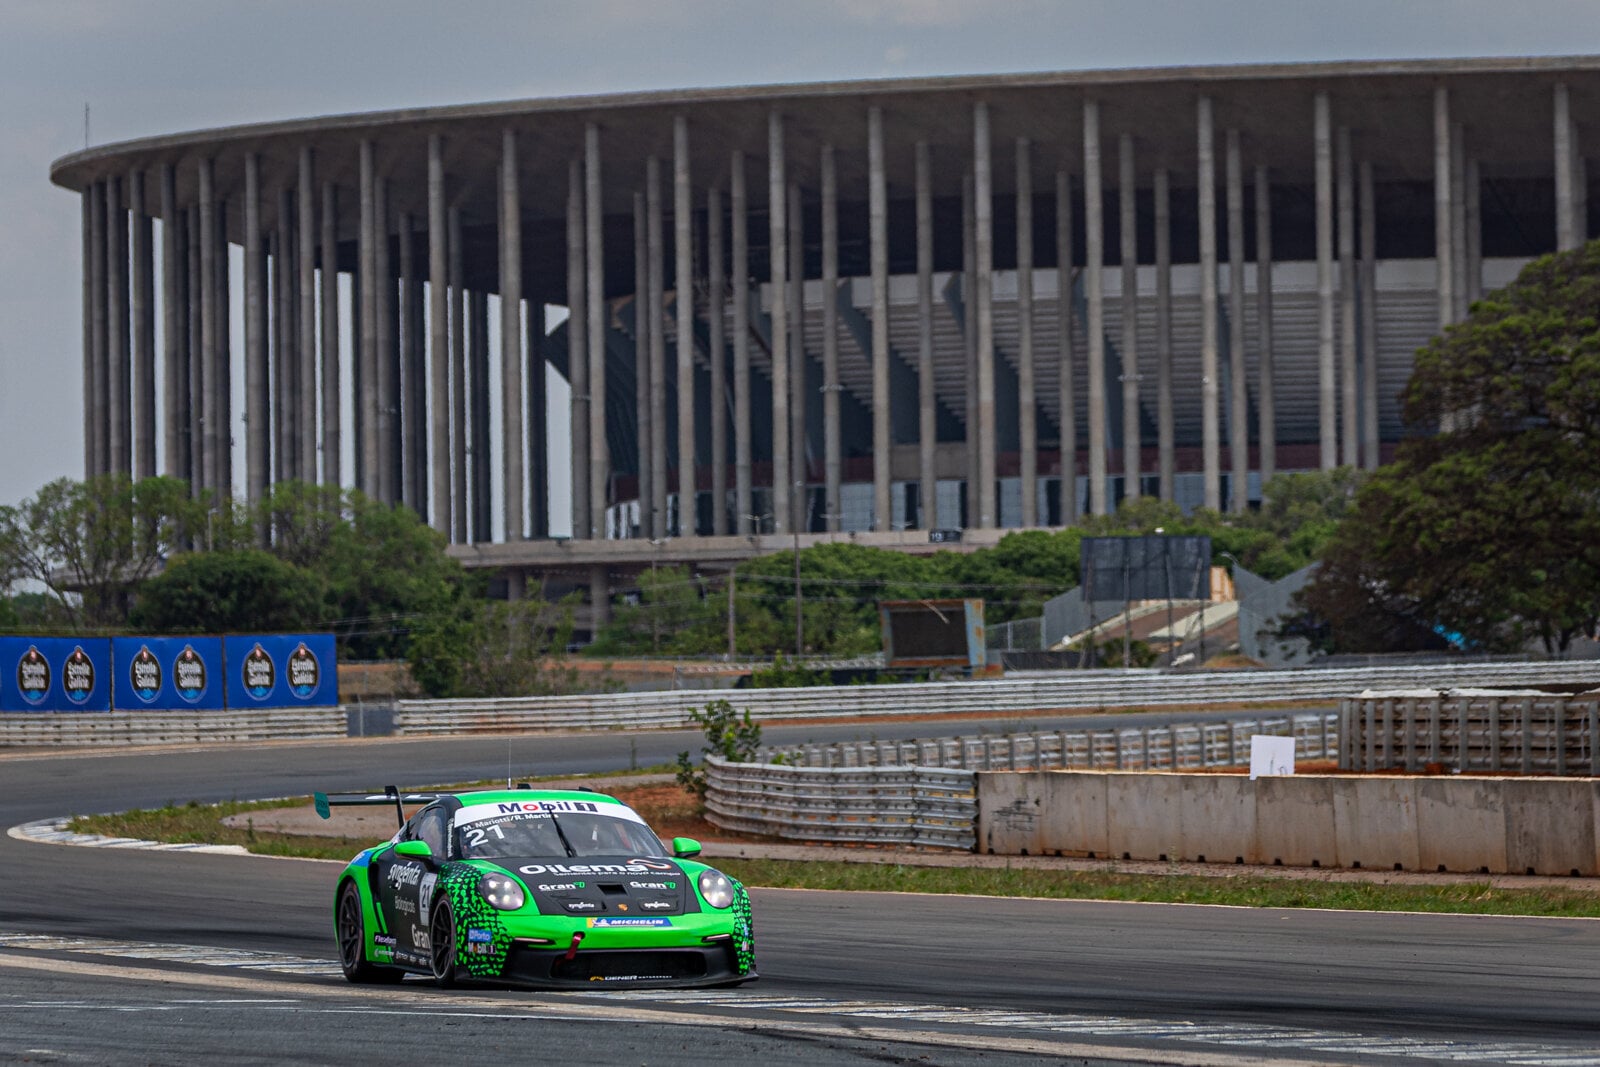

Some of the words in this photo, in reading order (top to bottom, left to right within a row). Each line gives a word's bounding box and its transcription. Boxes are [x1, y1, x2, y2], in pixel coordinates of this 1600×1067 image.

[498, 801, 571, 814] Mobil
[465, 825, 505, 847] 21
[519, 863, 649, 875] Oilema
[538, 883, 576, 891] Gran
[630, 881, 667, 890] Gran
[421, 884, 430, 908] 21
[411, 923, 431, 949] Gran
